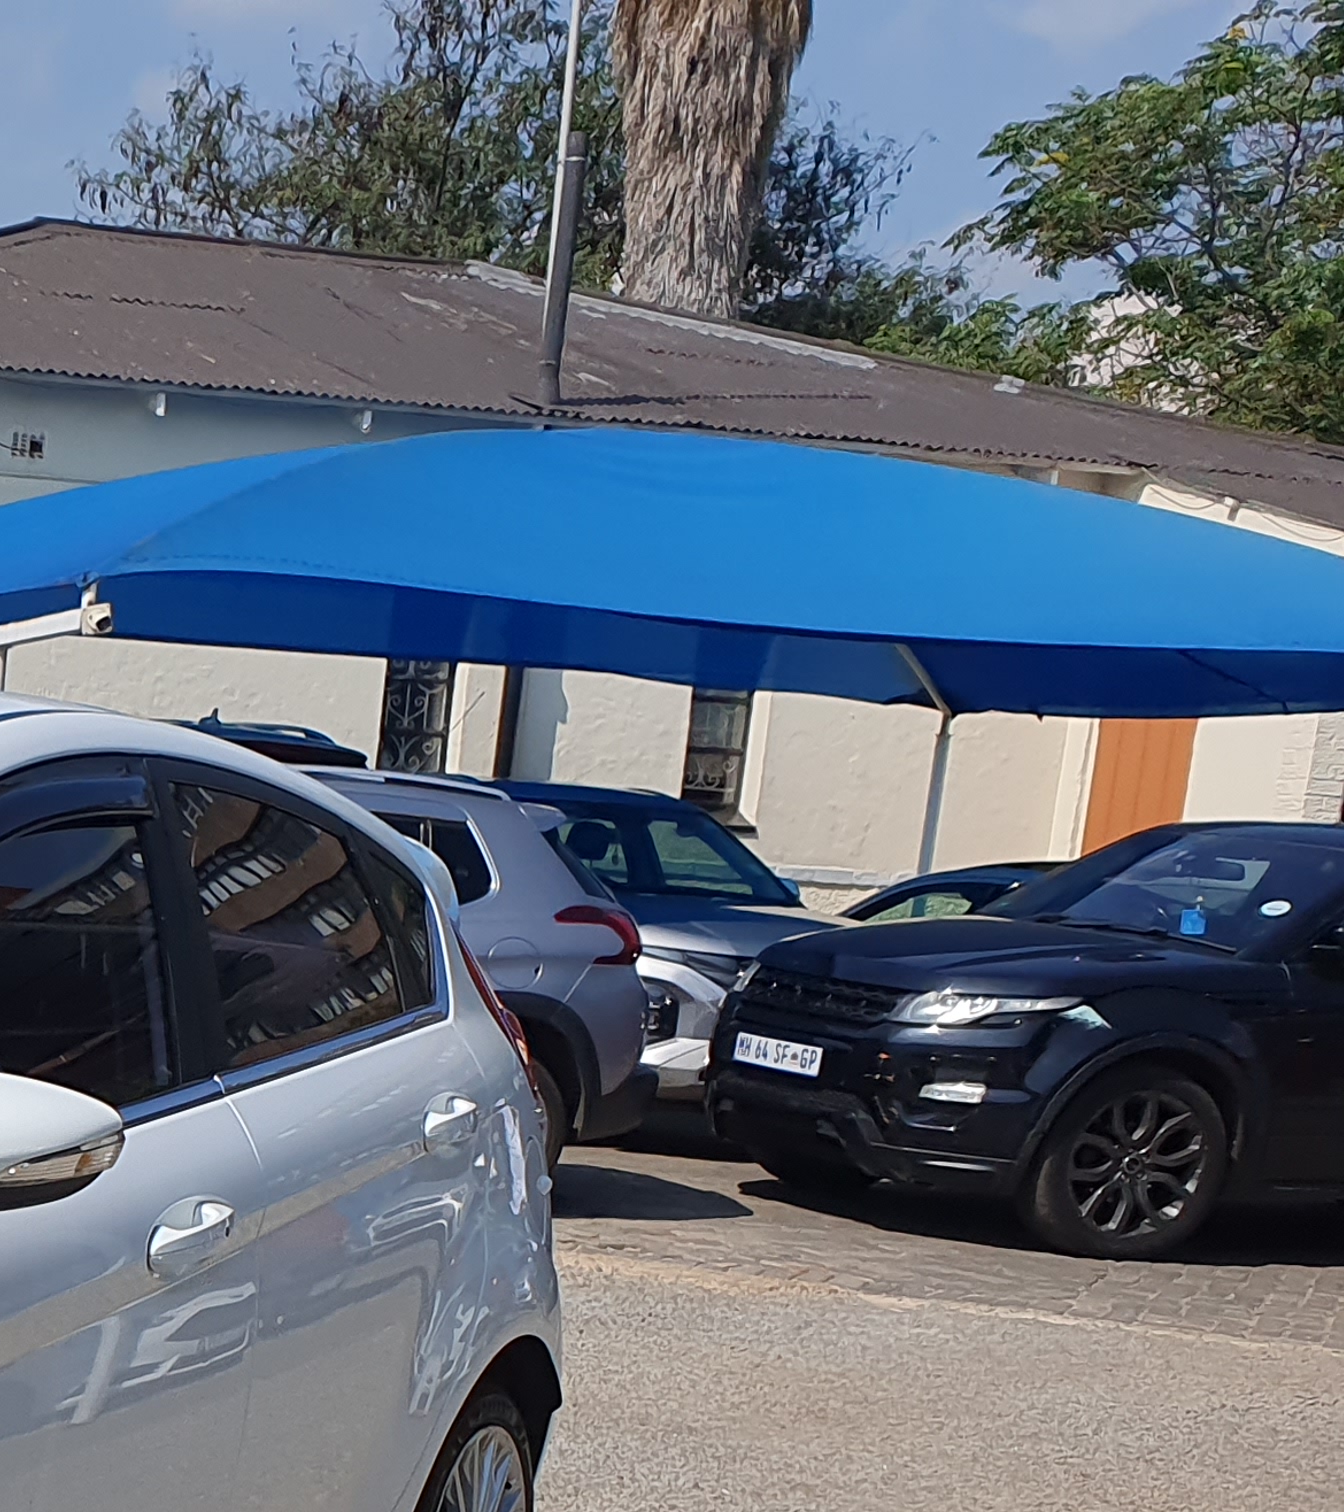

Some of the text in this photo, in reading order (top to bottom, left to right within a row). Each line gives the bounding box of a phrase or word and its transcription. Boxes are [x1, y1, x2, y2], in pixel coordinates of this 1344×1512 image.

[755, 1039, 769, 1060] 64
[773, 1042, 791, 1064] SF
[799, 1048, 818, 1070] GP
